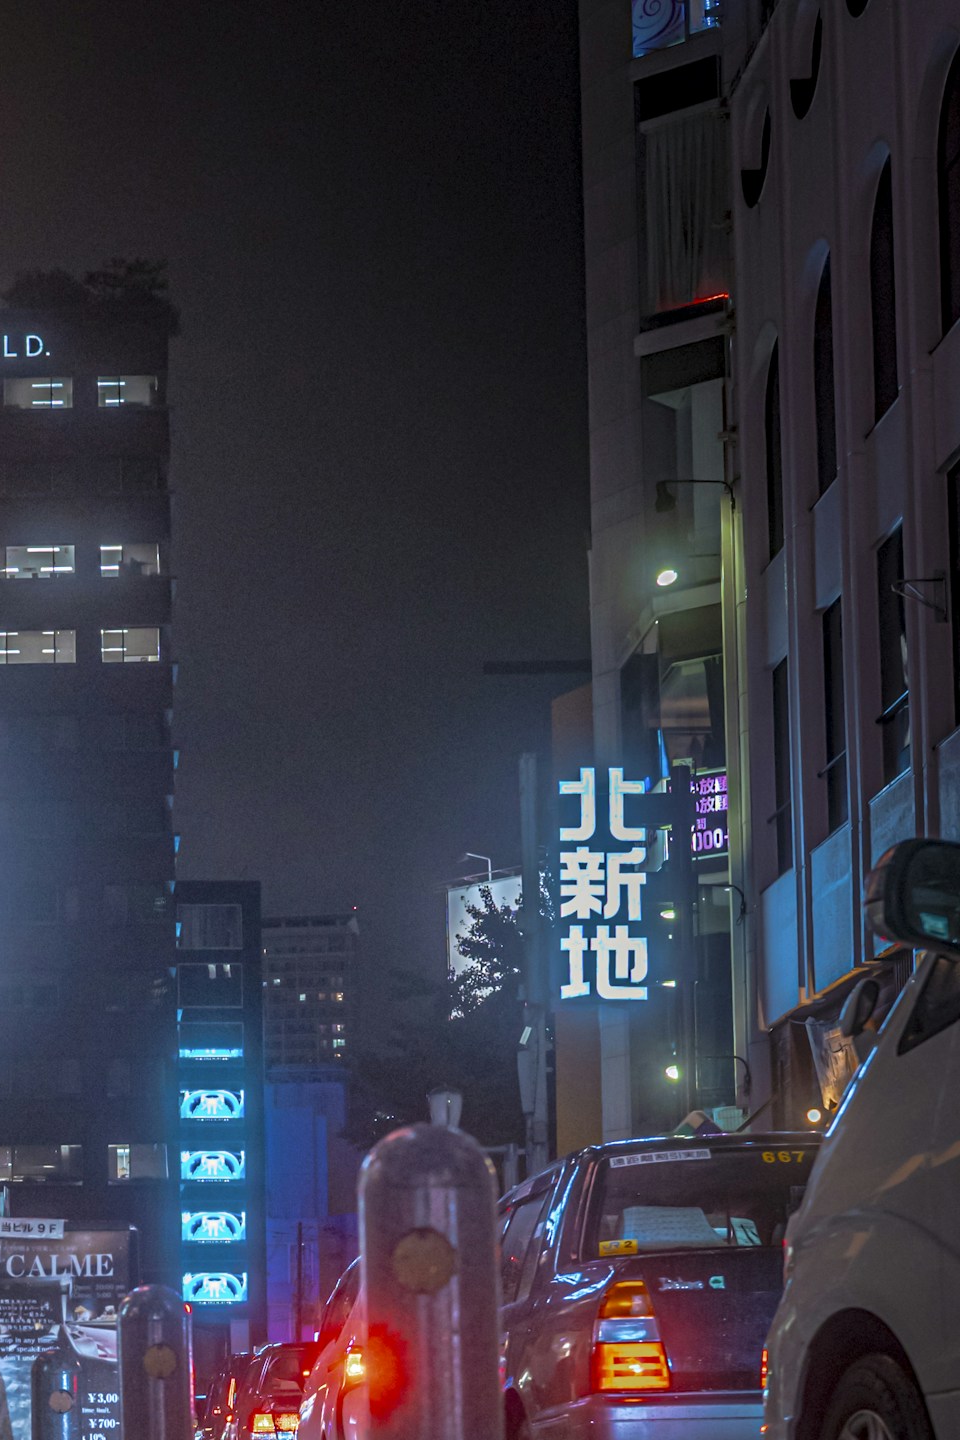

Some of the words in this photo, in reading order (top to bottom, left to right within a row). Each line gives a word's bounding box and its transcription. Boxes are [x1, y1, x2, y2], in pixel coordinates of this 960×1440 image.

[558, 767, 648, 1001] 北新地
[761, 1150, 805, 1164] 667
[5, 1253, 115, 1278] CALME
